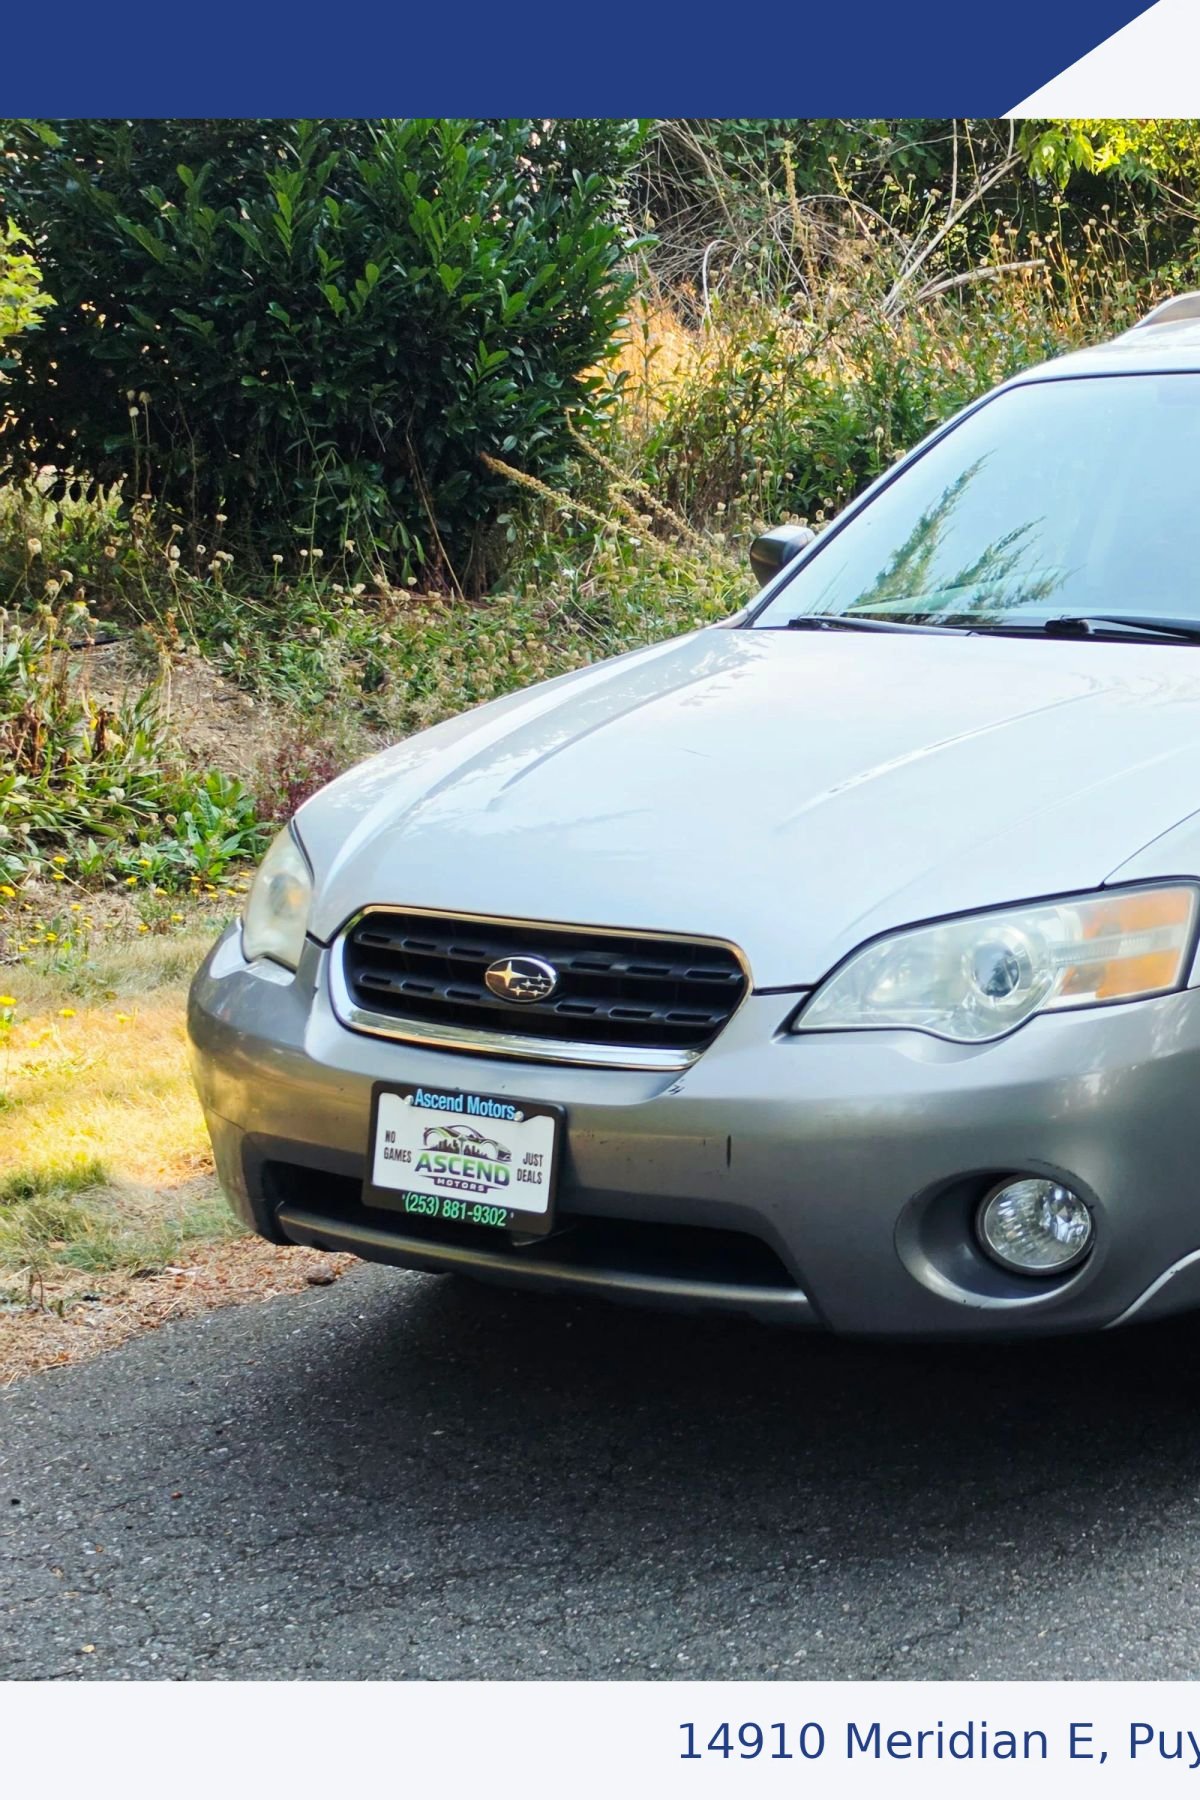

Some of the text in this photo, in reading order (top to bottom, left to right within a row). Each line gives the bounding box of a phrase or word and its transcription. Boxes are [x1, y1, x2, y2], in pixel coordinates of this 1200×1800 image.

[414, 1088, 516, 1120] Ascend Motors
[385, 1130, 396, 1144] NO
[383, 1147, 412, 1163] GAMES
[523, 1152, 544, 1167] JUST
[414, 1152, 510, 1186] ASCEND
[517, 1168, 543, 1185] DEALS
[436, 1177, 485, 1192] MOTORS
[404, 1191, 507, 1227] (253) 881-9302
